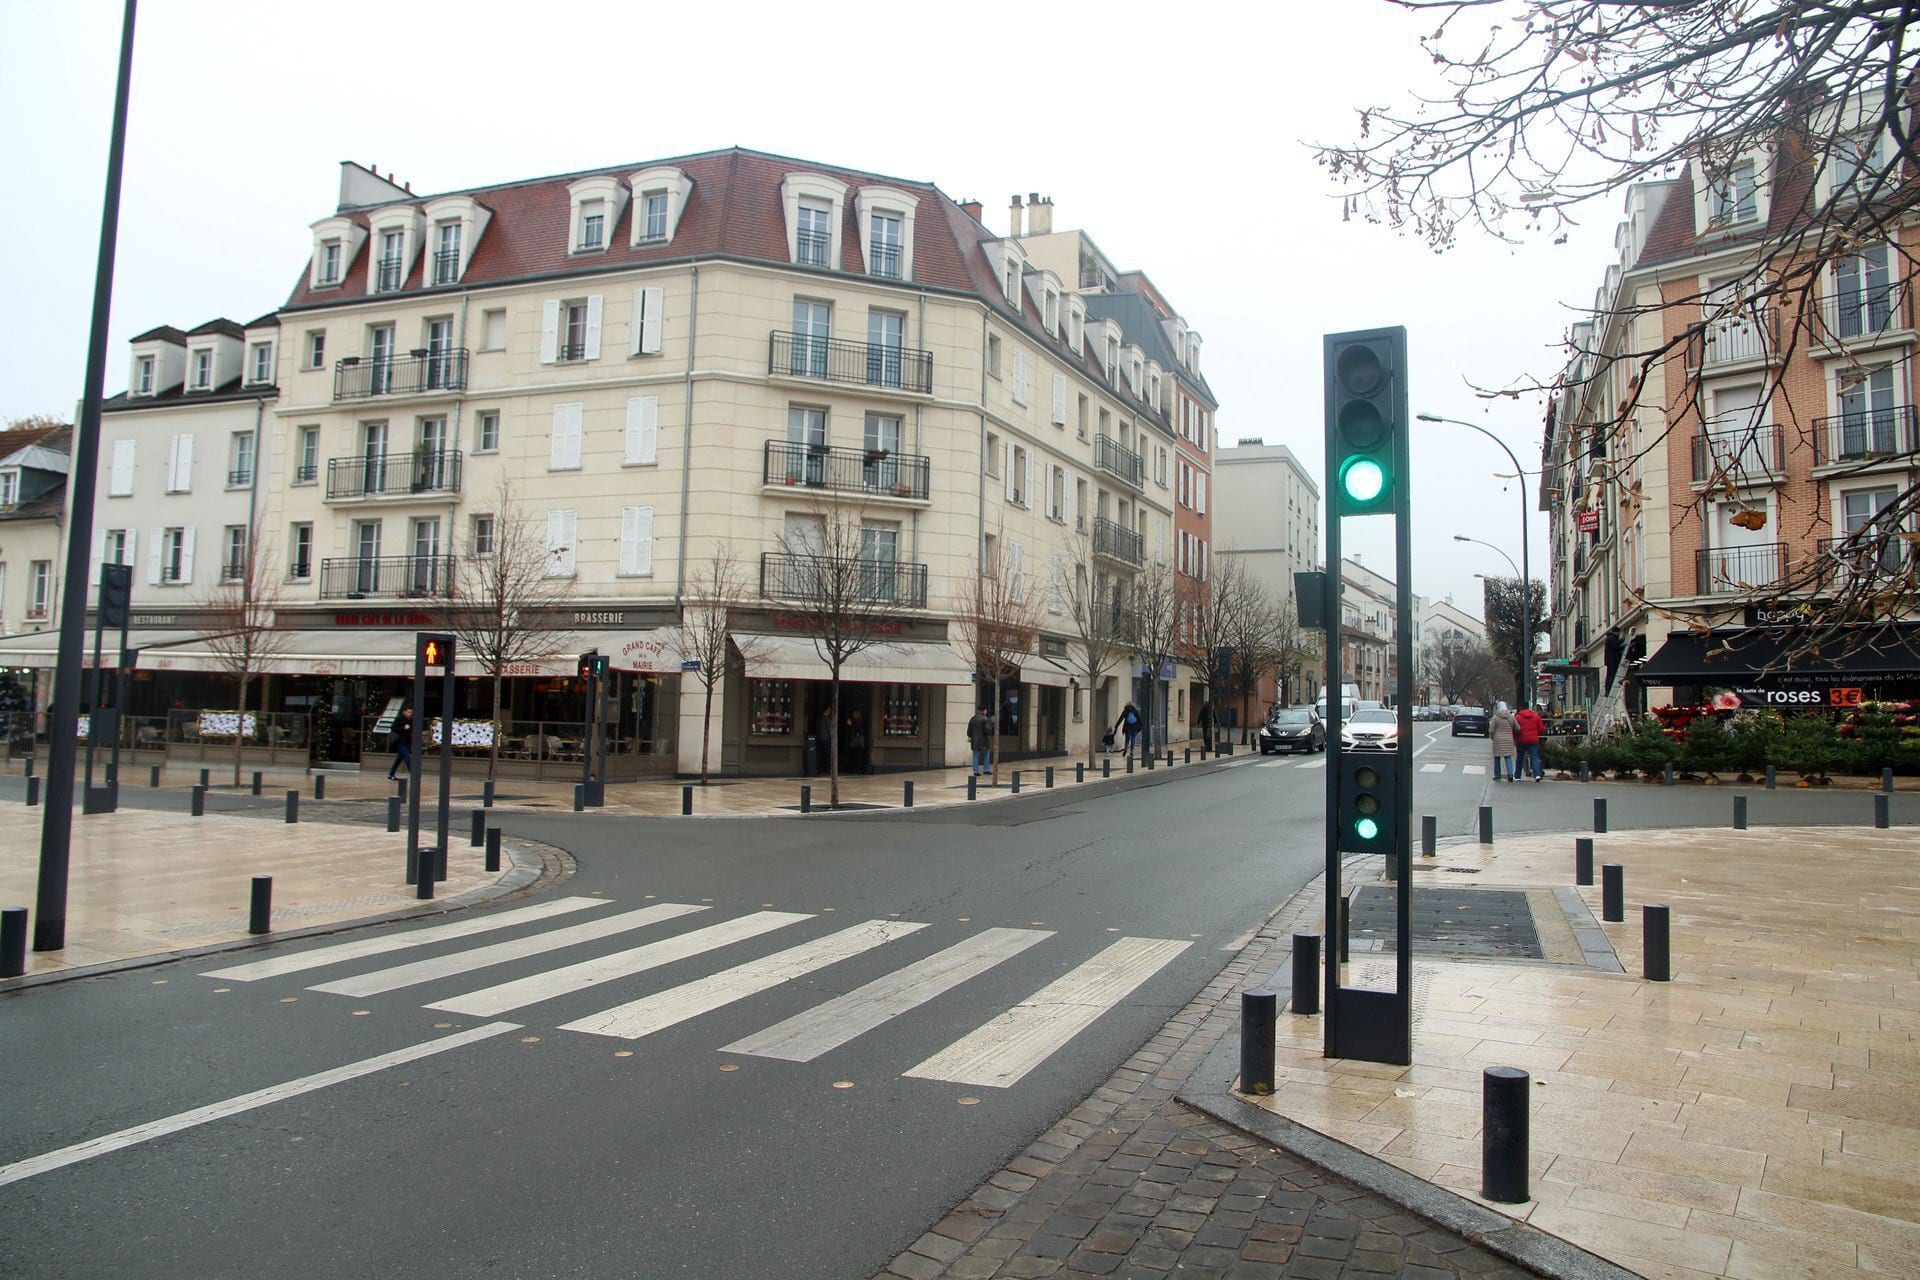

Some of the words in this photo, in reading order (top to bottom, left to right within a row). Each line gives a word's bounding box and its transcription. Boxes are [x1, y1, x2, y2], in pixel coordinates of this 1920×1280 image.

[133, 615, 176, 624] RESTAURANT
[574, 612, 624, 623] BRASSERIE
[622, 640, 644, 656] GRAND
[494, 663, 540, 674] ASSERIE
[632, 660, 653, 670] MAIRIE
[1767, 690, 1821, 703] roses
